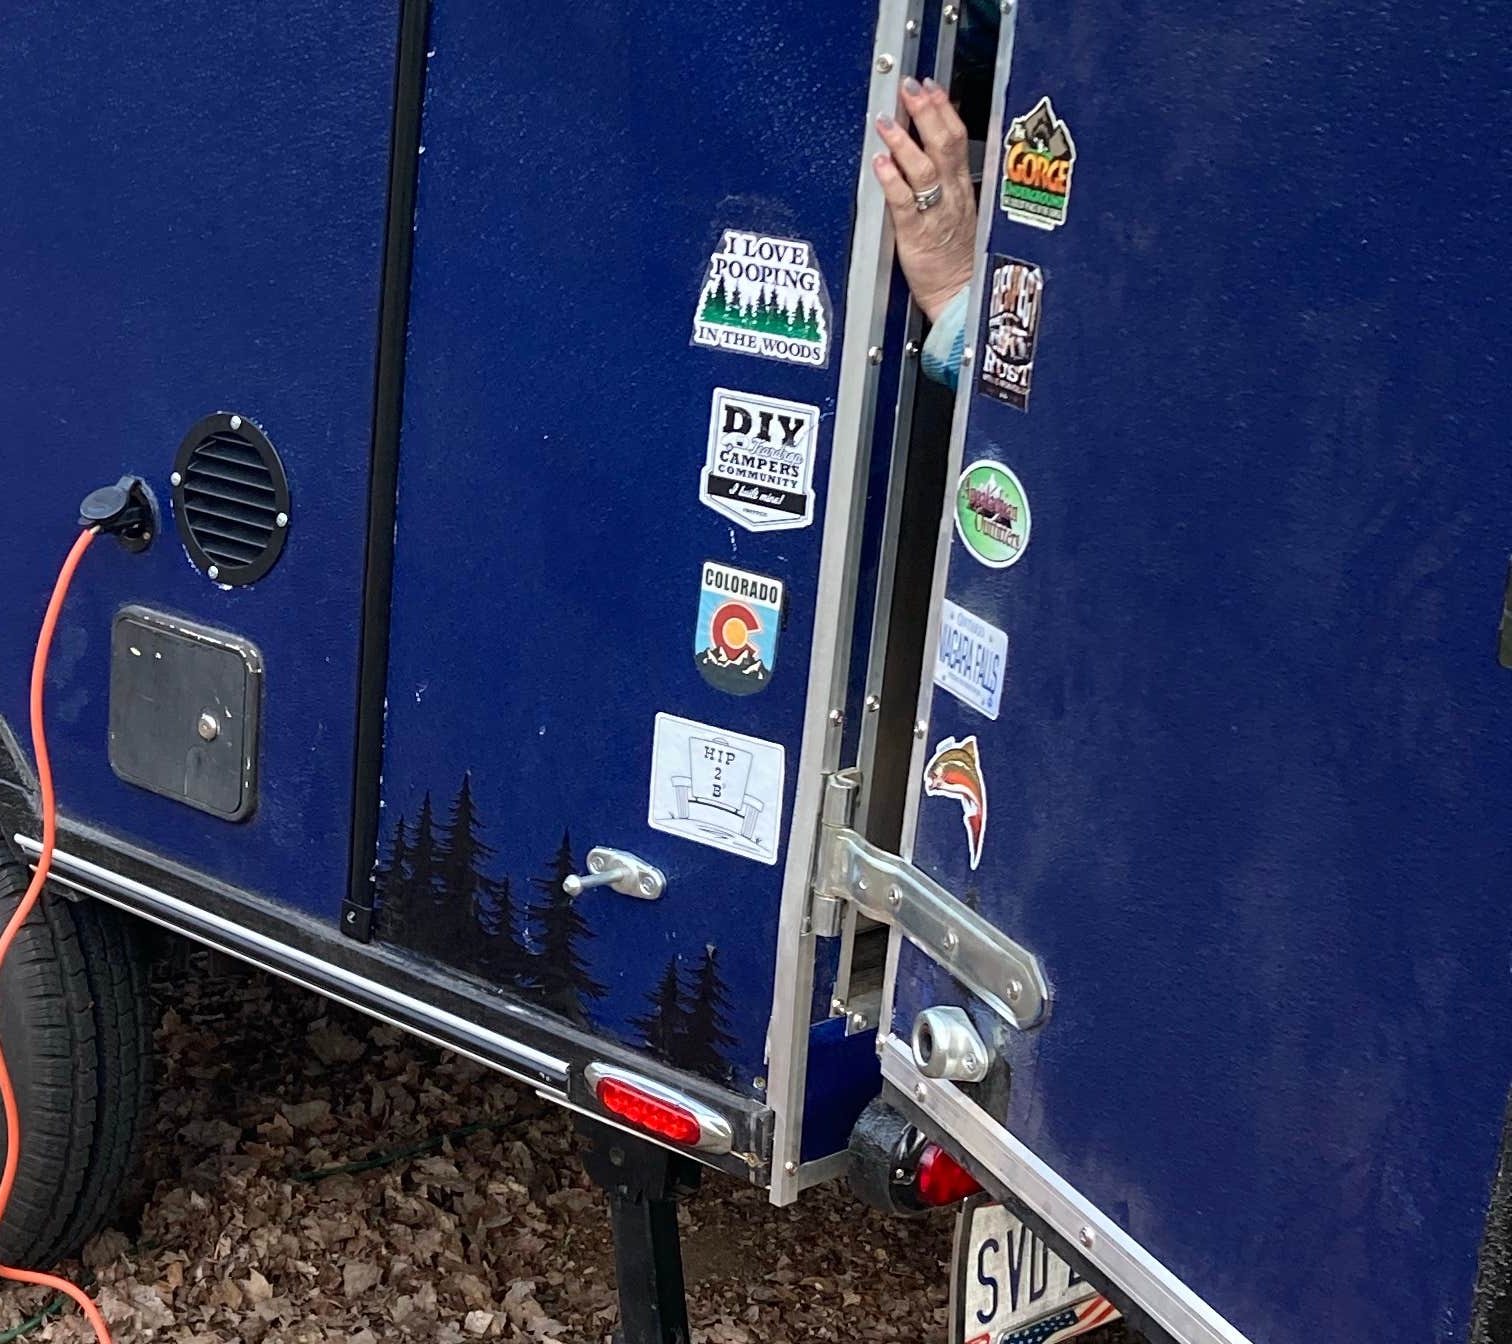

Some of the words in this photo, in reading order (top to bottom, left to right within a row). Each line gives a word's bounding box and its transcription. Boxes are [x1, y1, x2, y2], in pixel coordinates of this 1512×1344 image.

[1007, 141, 1069, 194] GORGE
[727, 237, 736, 254] I
[744, 239, 805, 265] LOVE
[714, 259, 815, 291] POOPING
[698, 326, 719, 341] IN
[723, 330, 757, 348] THE
[763, 338, 821, 360] WOODS
[722, 405, 804, 448] DIY
[718, 464, 798, 489] COMMUNITY
[719, 450, 800, 478] CAMPERS
[705, 568, 778, 604] COLORADO
[704, 746, 736, 765] HIP
[714, 767, 722, 780] 2
[712, 784, 722, 797] B
[976, 1223, 1048, 1325] SVD
